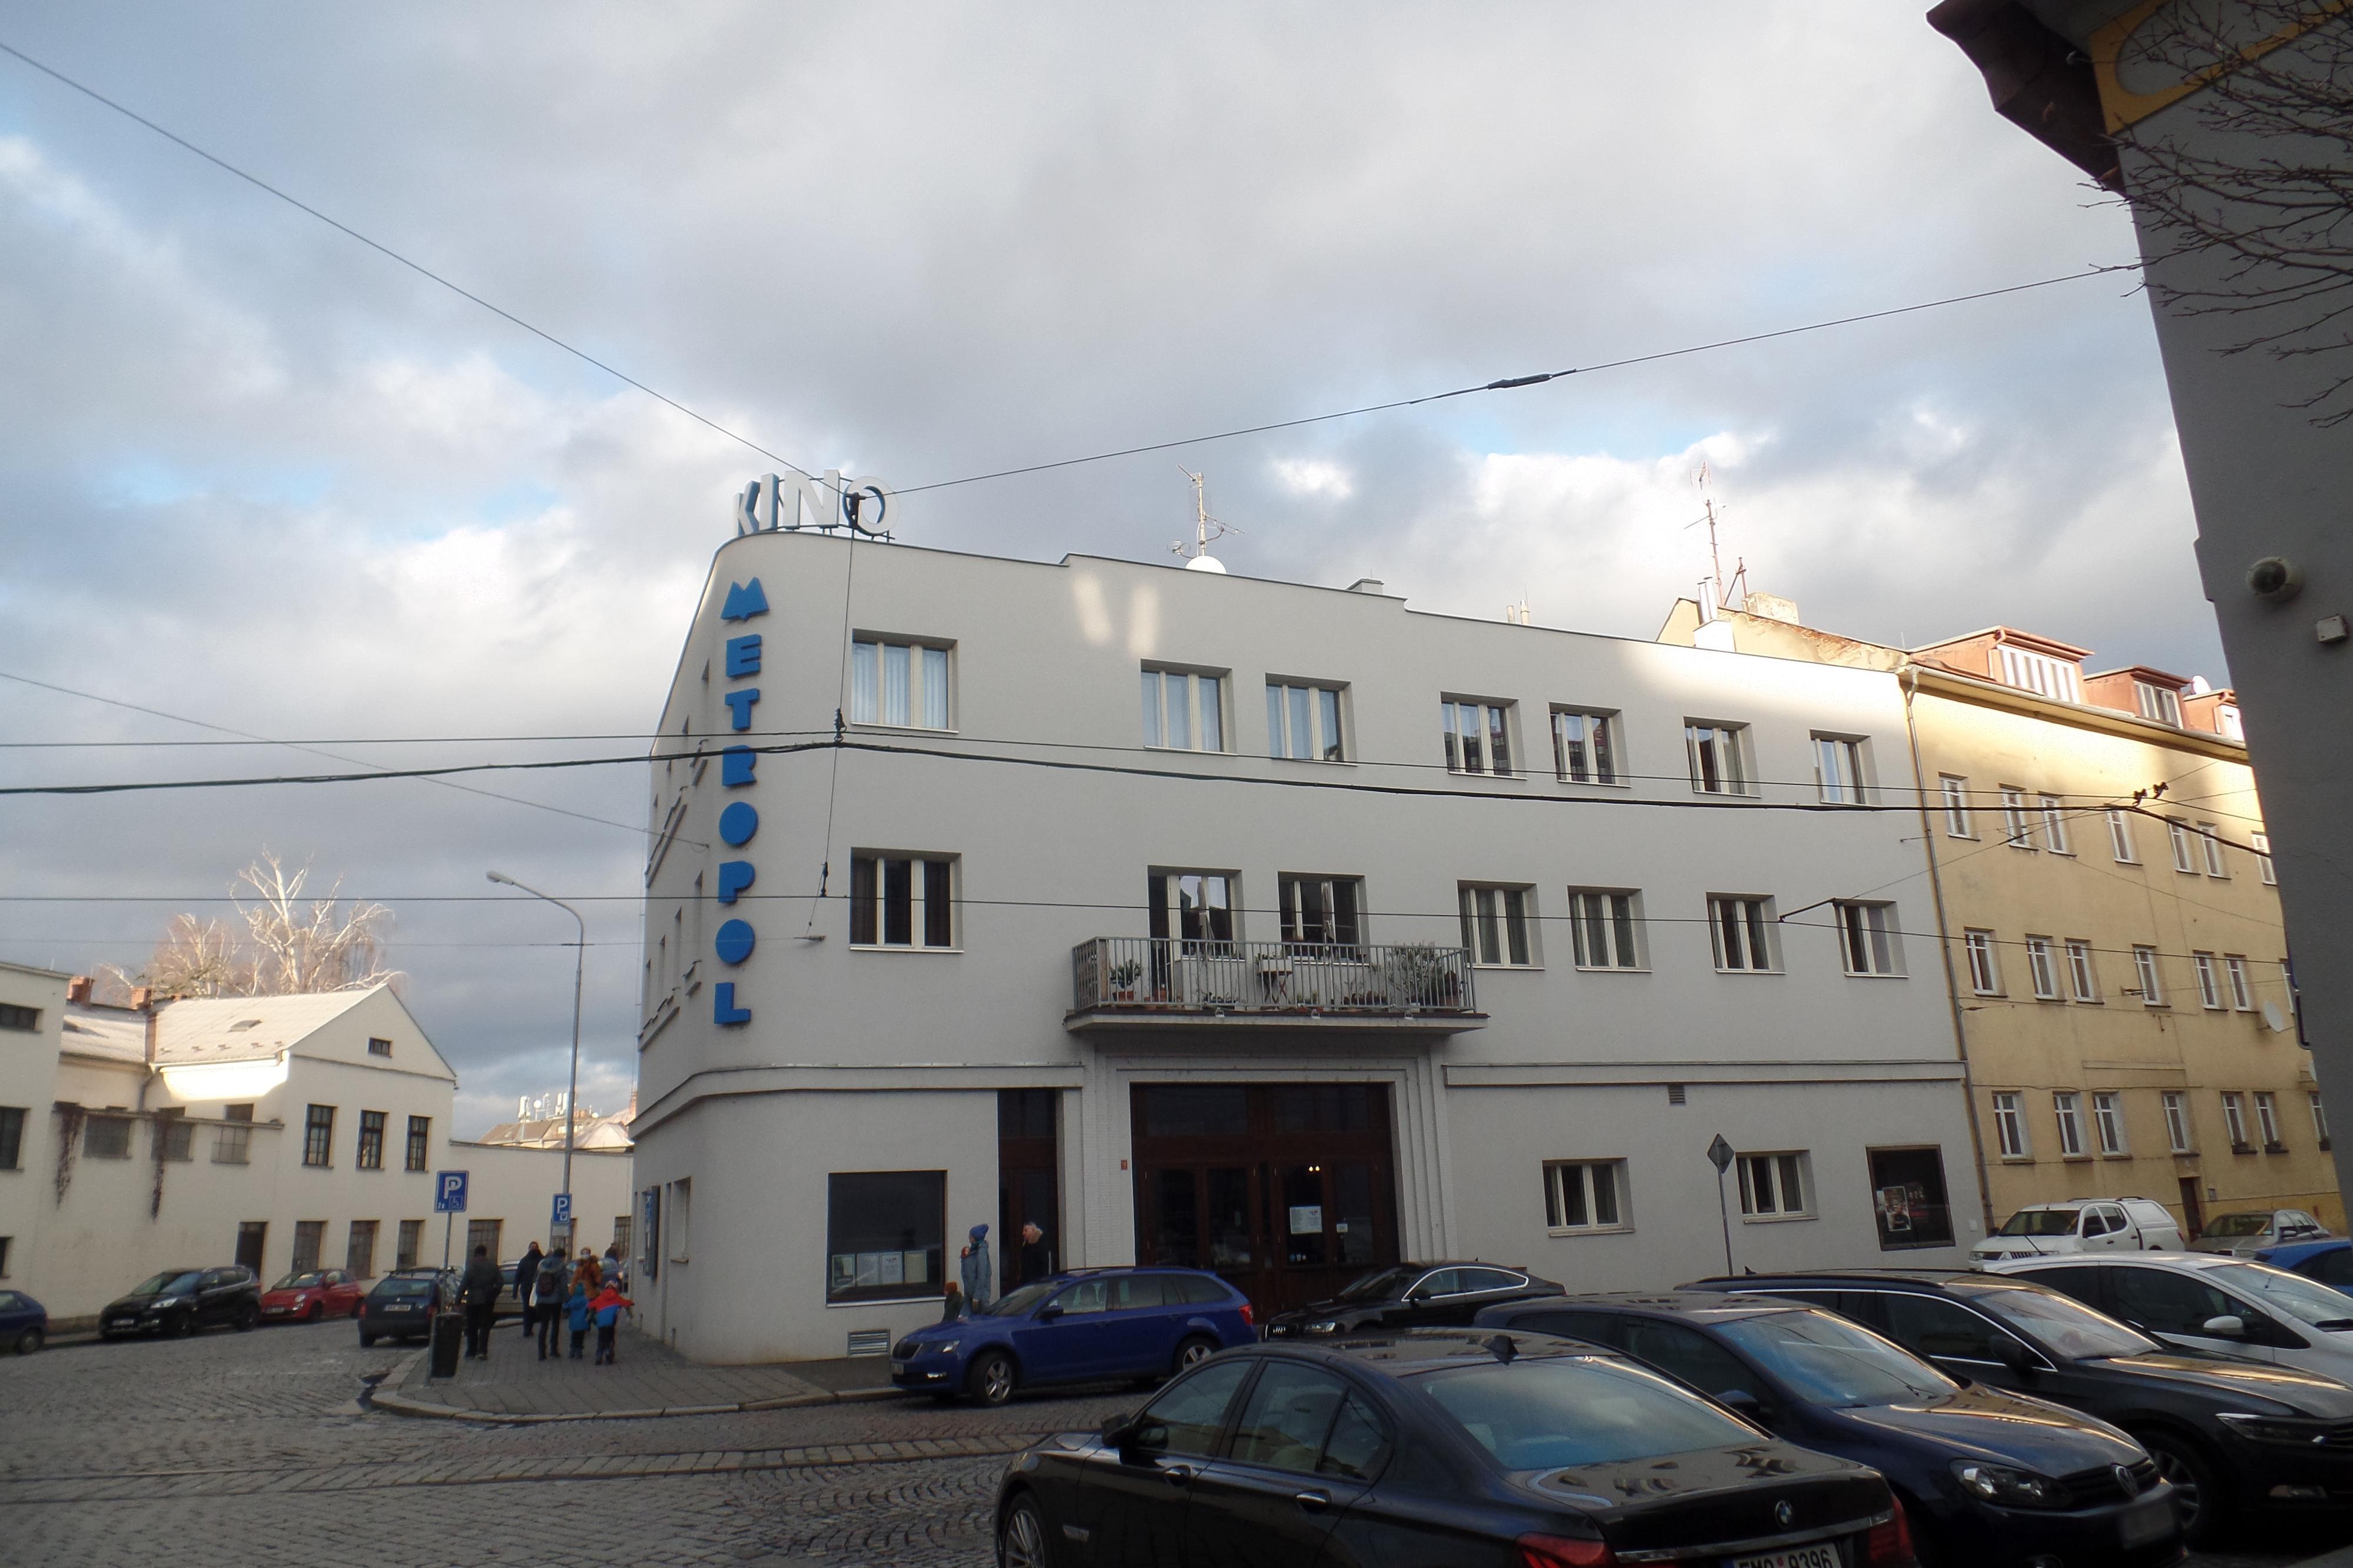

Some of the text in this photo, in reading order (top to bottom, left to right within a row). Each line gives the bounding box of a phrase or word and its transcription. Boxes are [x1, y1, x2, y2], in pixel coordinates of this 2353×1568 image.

[733, 469, 899, 536] KINO
[714, 576, 770, 1025] METROPOL
[444, 1176, 462, 1199] P
[557, 1197, 568, 1214] P
